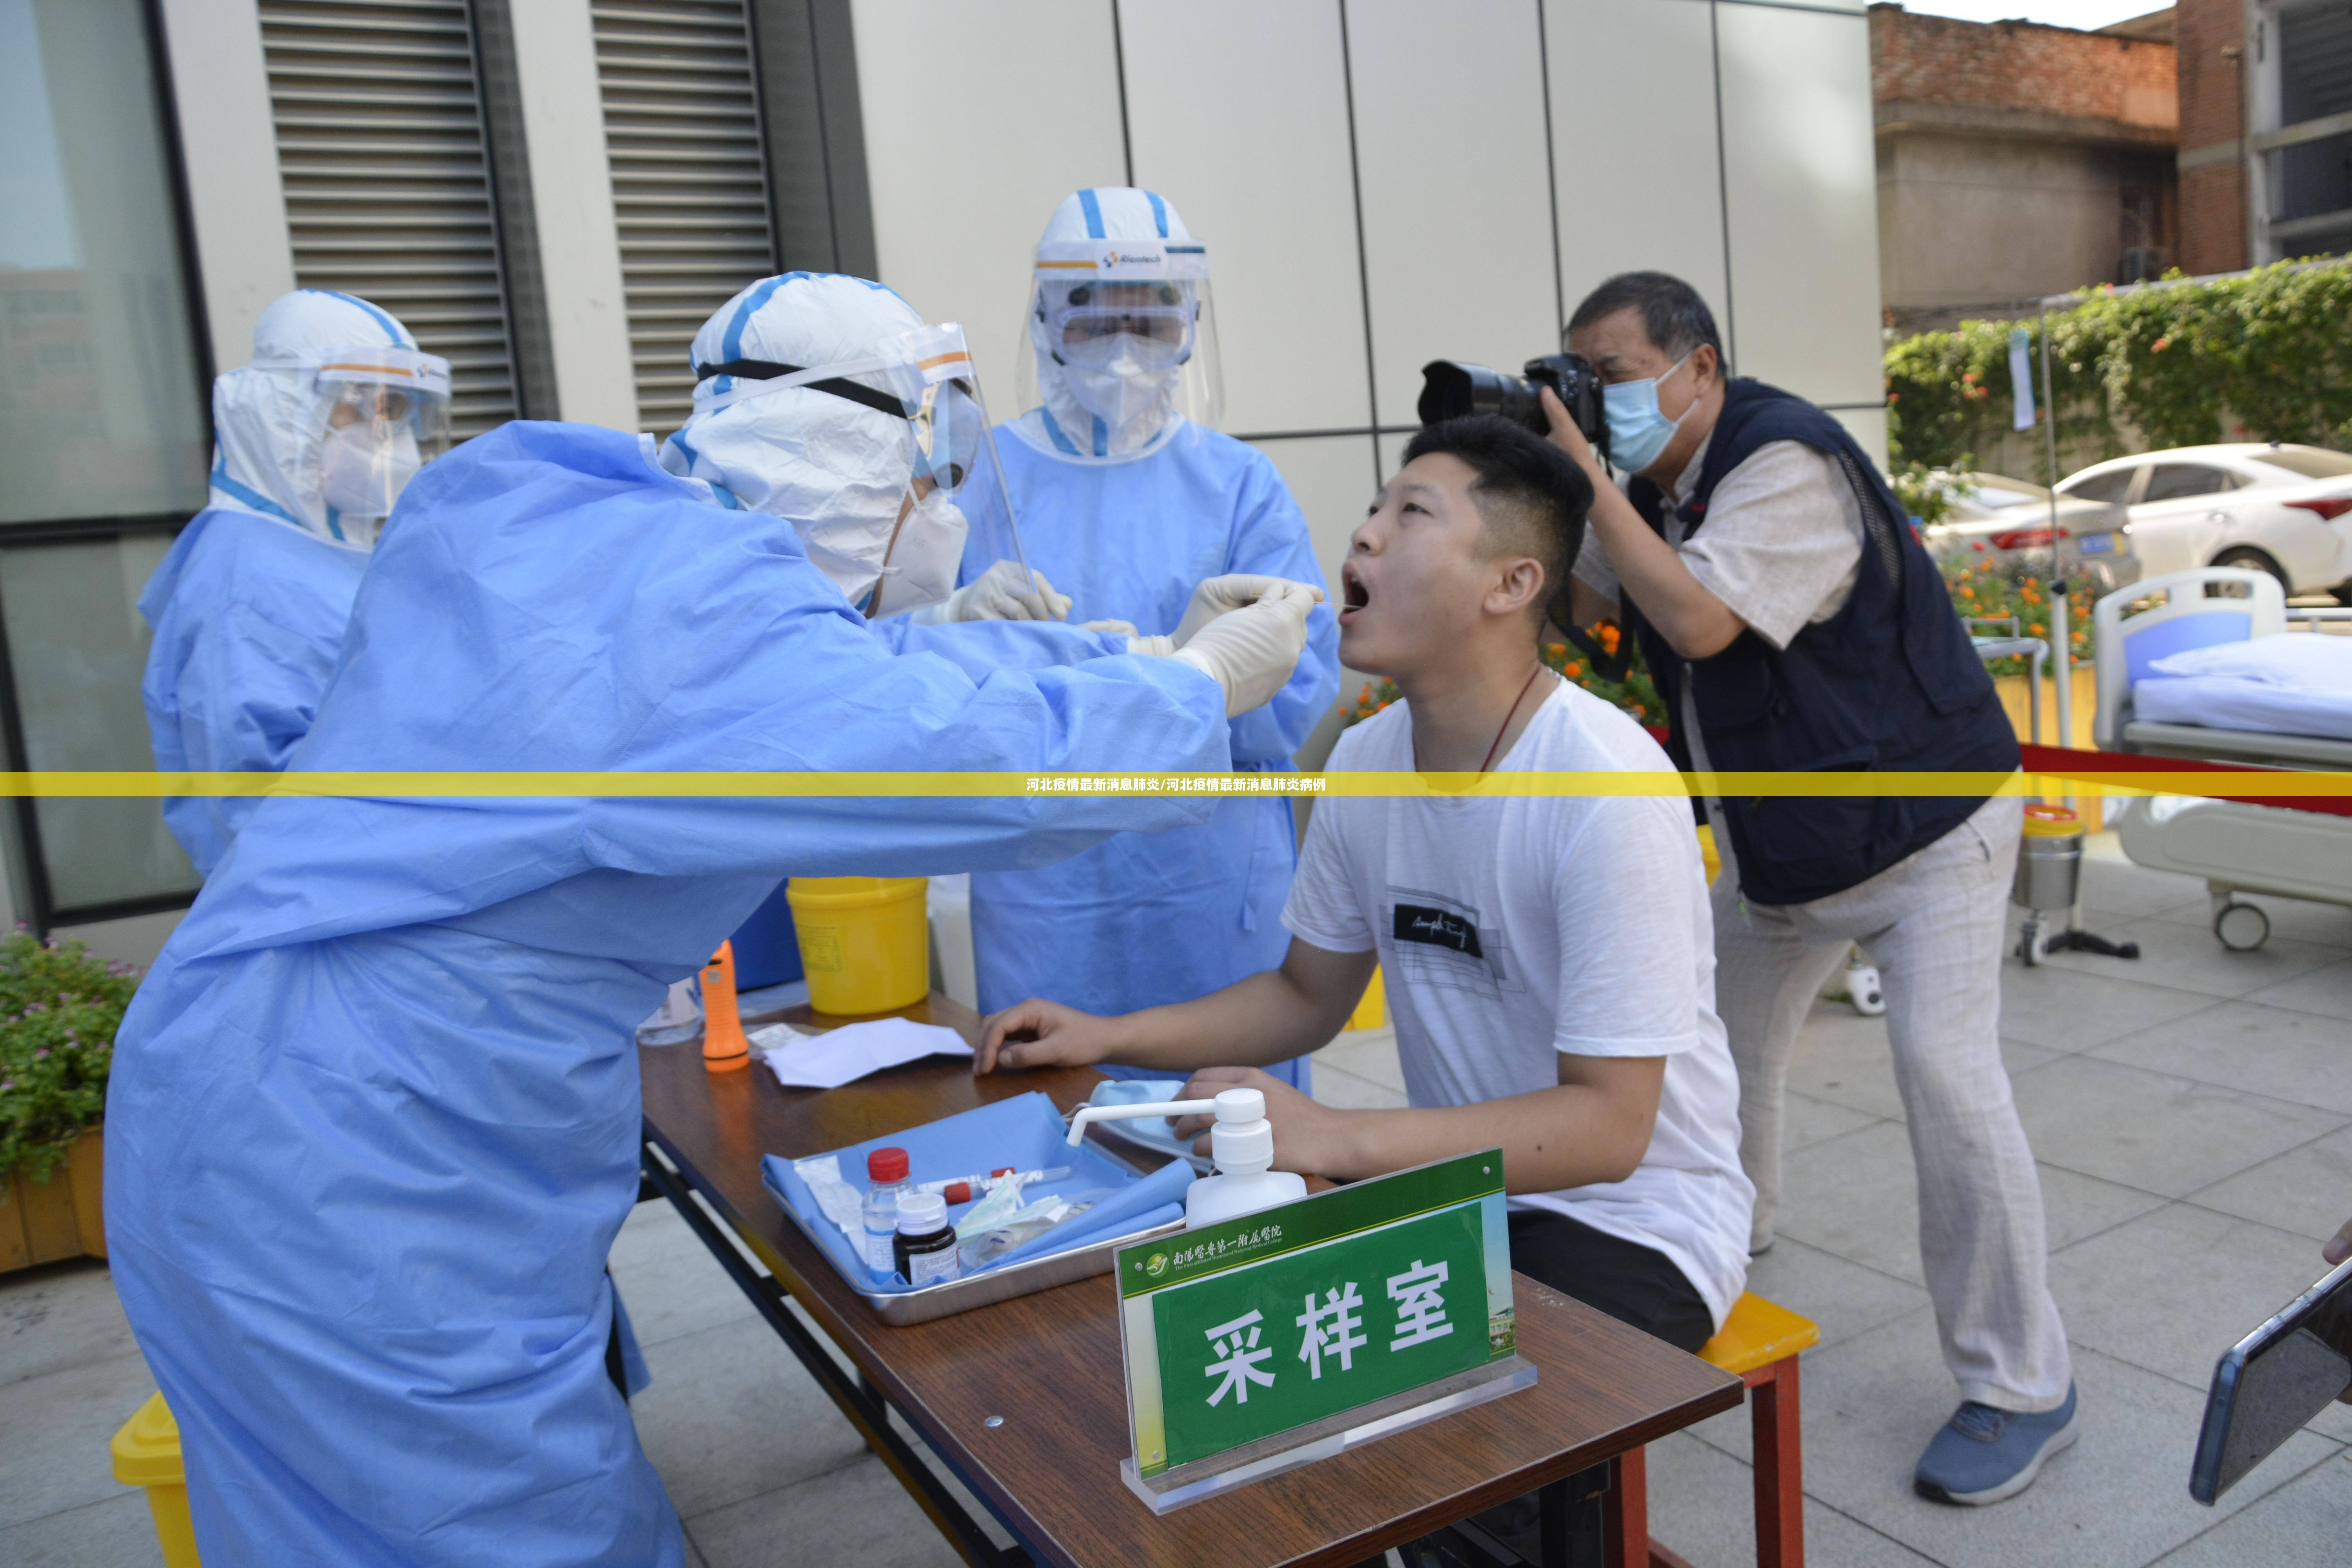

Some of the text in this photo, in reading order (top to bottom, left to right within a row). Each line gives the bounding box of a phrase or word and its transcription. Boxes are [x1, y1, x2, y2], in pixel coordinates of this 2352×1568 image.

[1212, 1252, 1229, 1261] Hospital
[1234, 1246, 1252, 1254] Nanyang
[1252, 1241, 1267, 1249] Medical
[1205, 1259, 1454, 1407] 采样室
